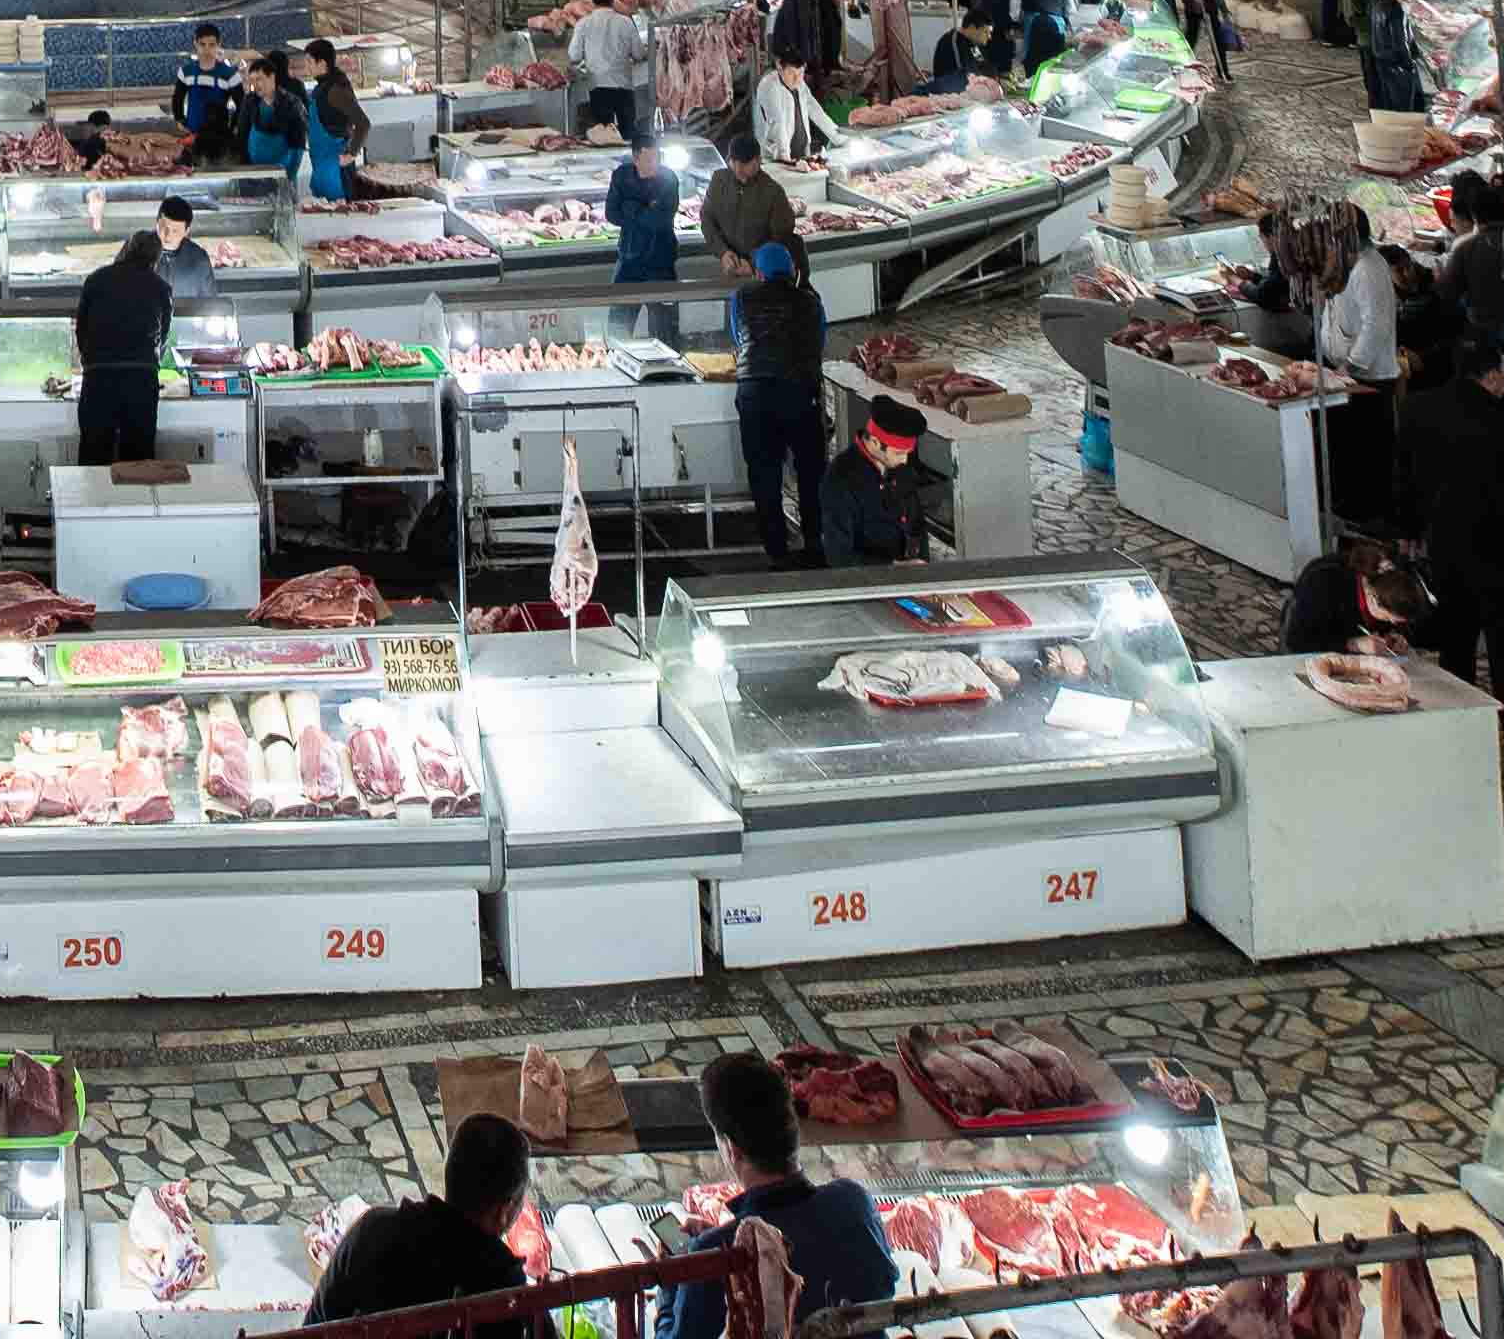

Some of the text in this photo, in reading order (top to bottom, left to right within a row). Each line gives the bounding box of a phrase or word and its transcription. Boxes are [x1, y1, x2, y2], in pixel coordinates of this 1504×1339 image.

[419, 639, 455, 655] БОР
[1047, 870, 1097, 903] 247
[813, 892, 867, 925] 248
[63, 937, 122, 968] 250
[327, 928, 385, 958] 249
